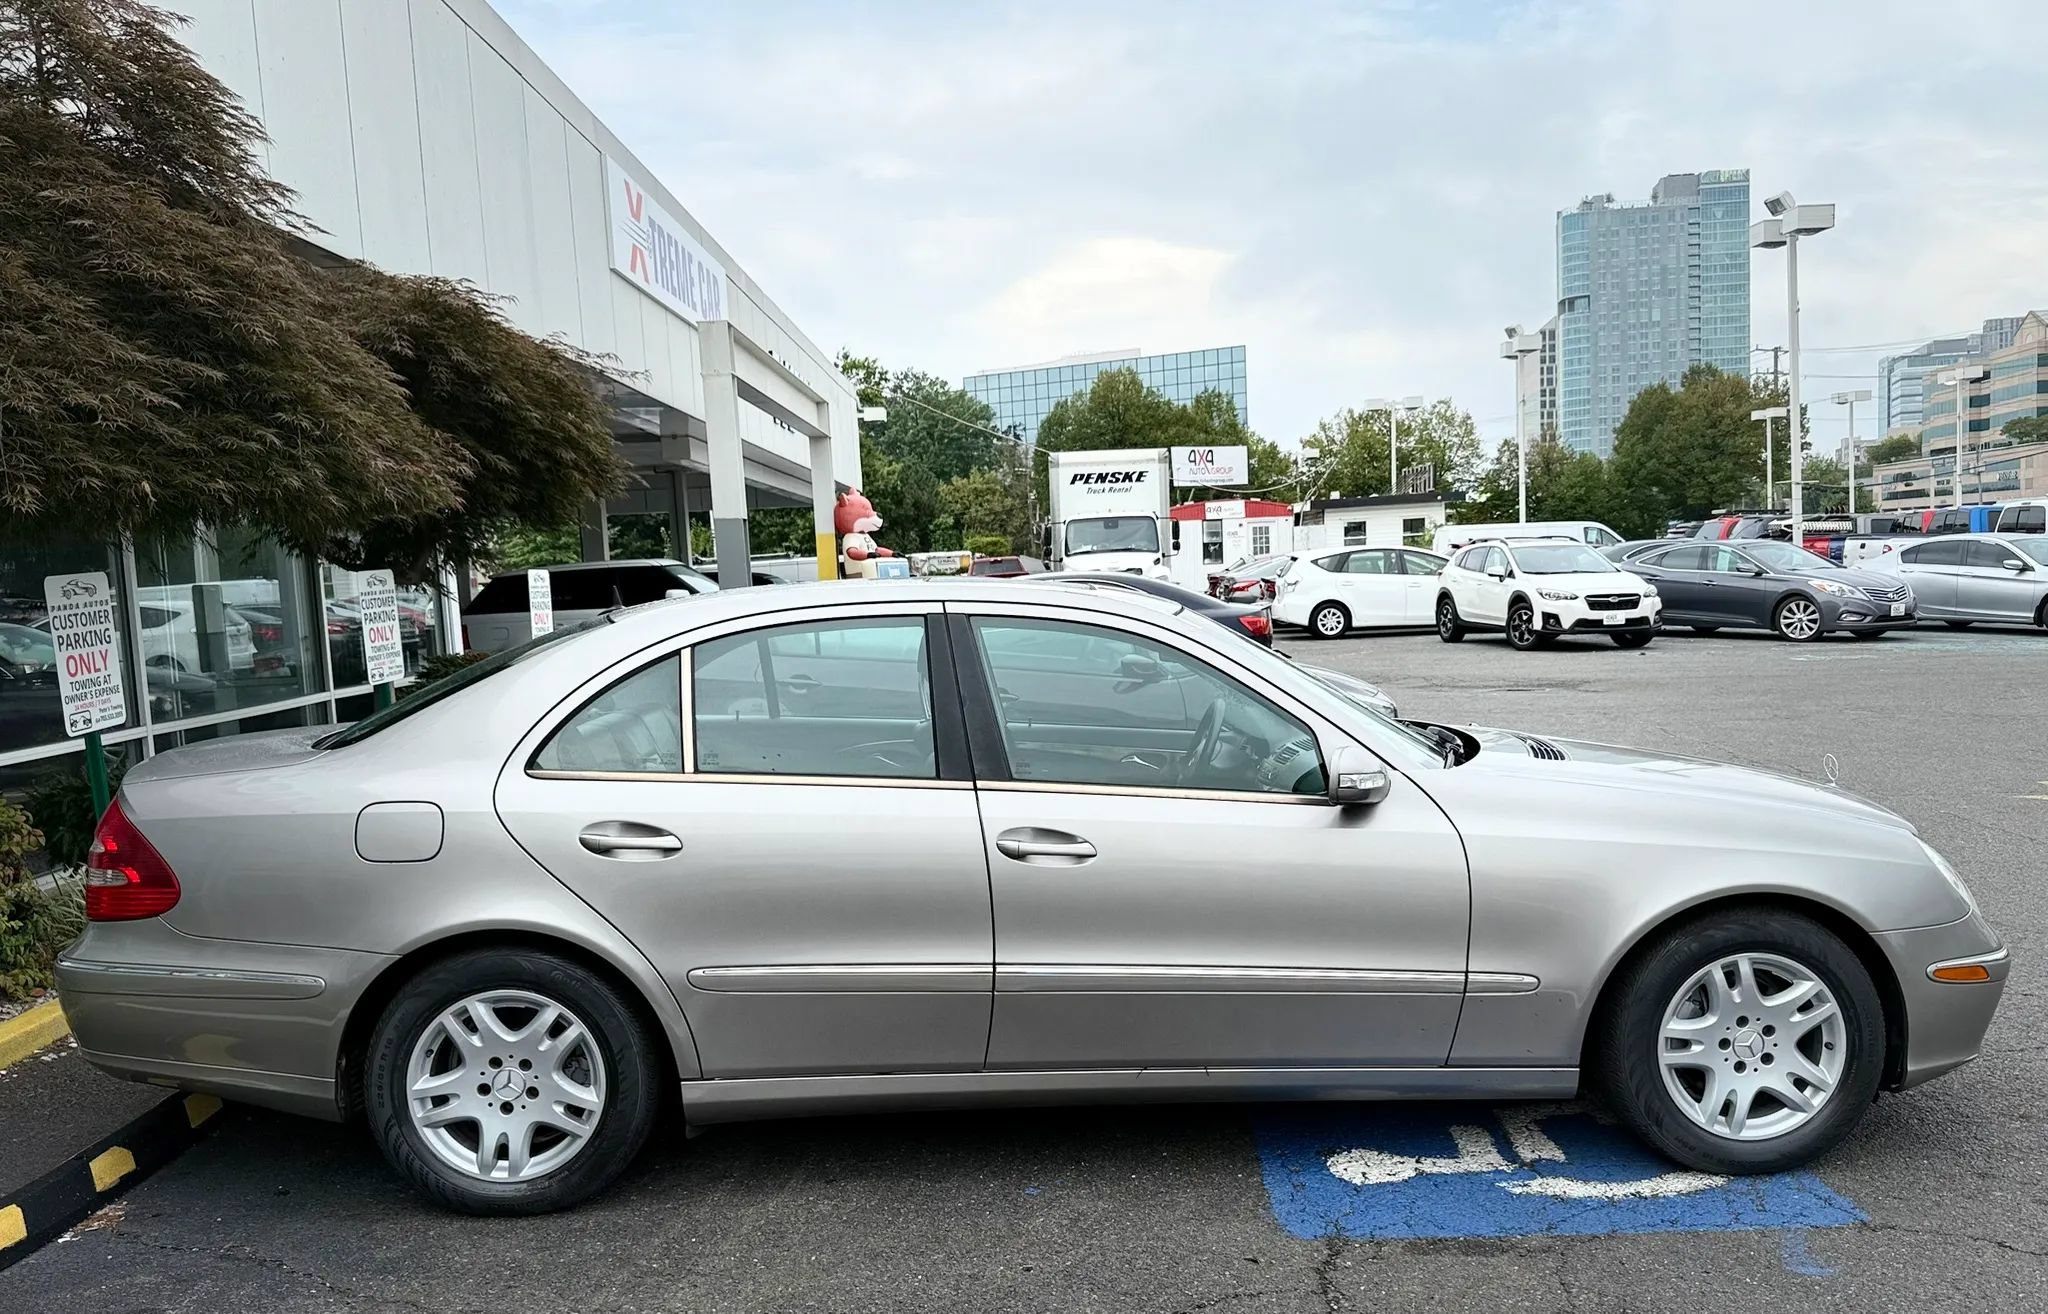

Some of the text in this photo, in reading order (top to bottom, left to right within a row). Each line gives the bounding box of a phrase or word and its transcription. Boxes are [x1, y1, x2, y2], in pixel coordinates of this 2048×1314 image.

[698, 261, 721, 320] CAR
[1070, 471, 1149, 485] PENSKE
[1189, 466, 1234, 475] AUTO GROUP
[1086, 485, 1133, 495] Truck Rental
[50, 598, 110, 613] PANDA AUTOS
[361, 595, 396, 610] CUSTOMER
[51, 609, 111, 631] CUSTOMER
[363, 609, 397, 625] PARKING
[56, 628, 112, 652] PARKING
[368, 624, 394, 644] ONLY
[66, 649, 108, 678] ONLY
[69, 674, 112, 692] TOWING AT
[64, 684, 121, 705] OWNER'S EXPENSE
